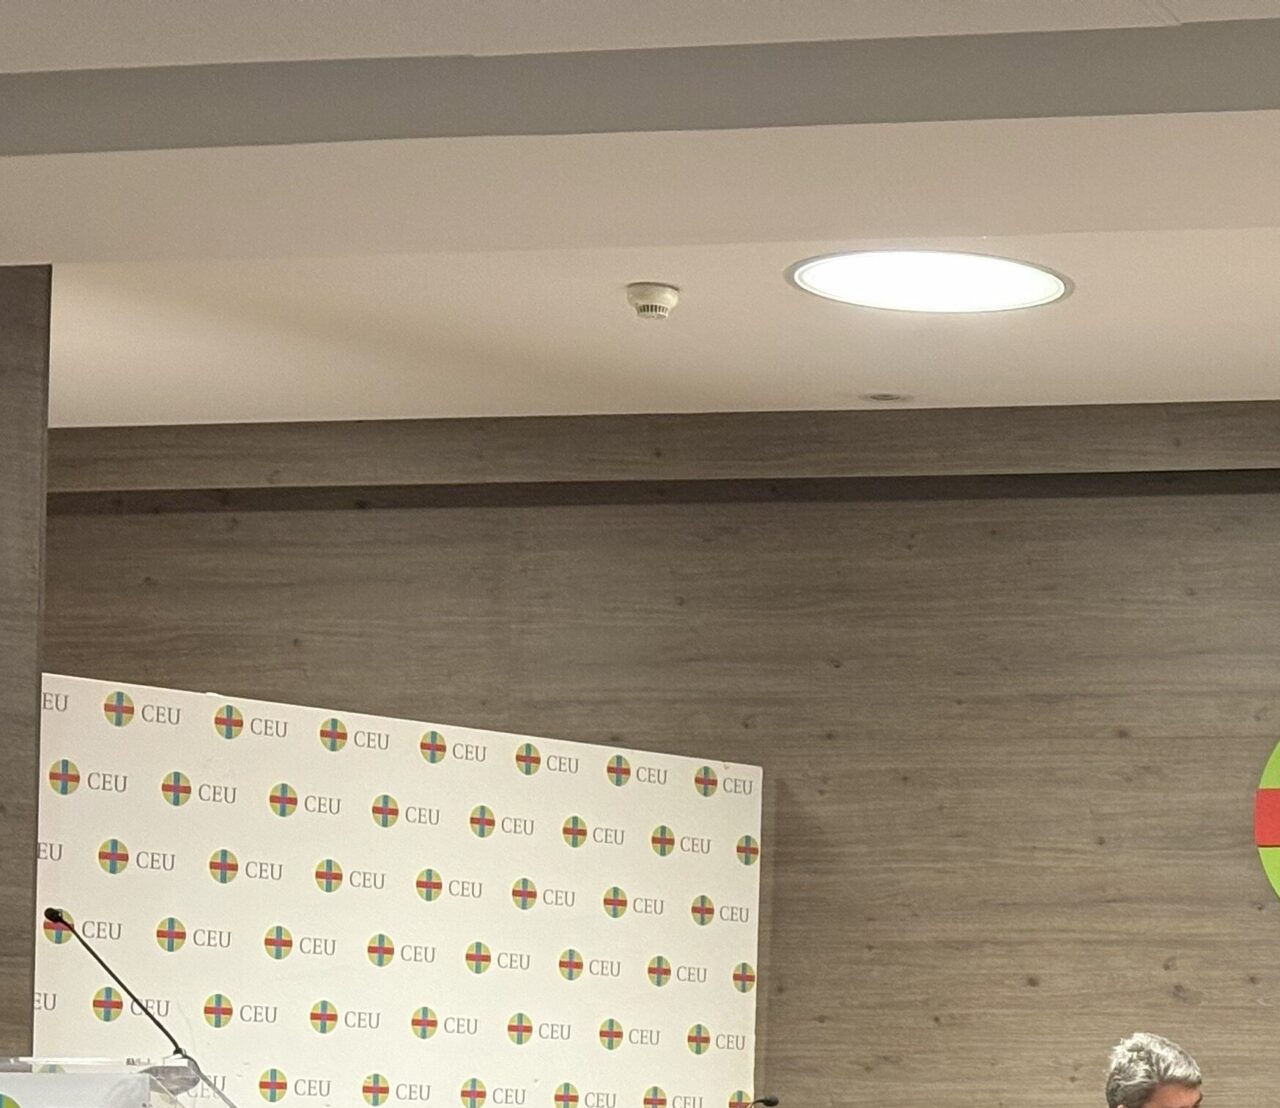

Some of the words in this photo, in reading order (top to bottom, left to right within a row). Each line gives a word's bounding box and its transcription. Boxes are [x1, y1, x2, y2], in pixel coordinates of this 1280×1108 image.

[43, 692, 68, 711] EU
[141, 703, 183, 725] CEU
[250, 716, 289, 738] CEU
[354, 729, 390, 750] CEU
[452, 742, 488, 762] CEU
[546, 755, 580, 774] CEU
[87, 772, 128, 793] CEU
[636, 766, 668, 785] CEU
[198, 784, 237, 804] CEU
[722, 776, 753, 796] CEU
[304, 795, 342, 815] CEU
[405, 806, 440, 825] CEU
[501, 817, 534, 836] CEU
[593, 827, 625, 845] CEU
[37, 842, 62, 861] EU
[680, 836, 712, 854] CEU
[136, 851, 176, 871] CEU
[245, 861, 283, 880] CEU
[349, 870, 386, 889] CEU
[448, 880, 483, 898] CEU
[543, 889, 575, 907] CEU
[633, 897, 664, 915] CEU
[719, 905, 749, 923] CEU
[81, 921, 122, 940] CEU
[193, 929, 232, 948] CEU
[299, 937, 336, 956] CEU
[400, 945, 436, 963] CEU
[497, 952, 530, 971] CEU
[589, 959, 621, 977] CEU
[676, 966, 707, 983] CEU
[34, 992, 57, 1010] EU
[240, 1005, 278, 1023] CEU
[344, 1011, 381, 1029] CEU
[444, 1017, 478, 1035] CEU
[538, 1023, 571, 1040] CEU
[628, 1028, 661, 1045] CEU
[715, 1033, 746, 1050] CEU
[294, 1079, 332, 1097] CEU
[396, 1083, 431, 1101] CEU
[492, 1088, 526, 1105] CEU
[584, 1092, 616, 1108] CEU
